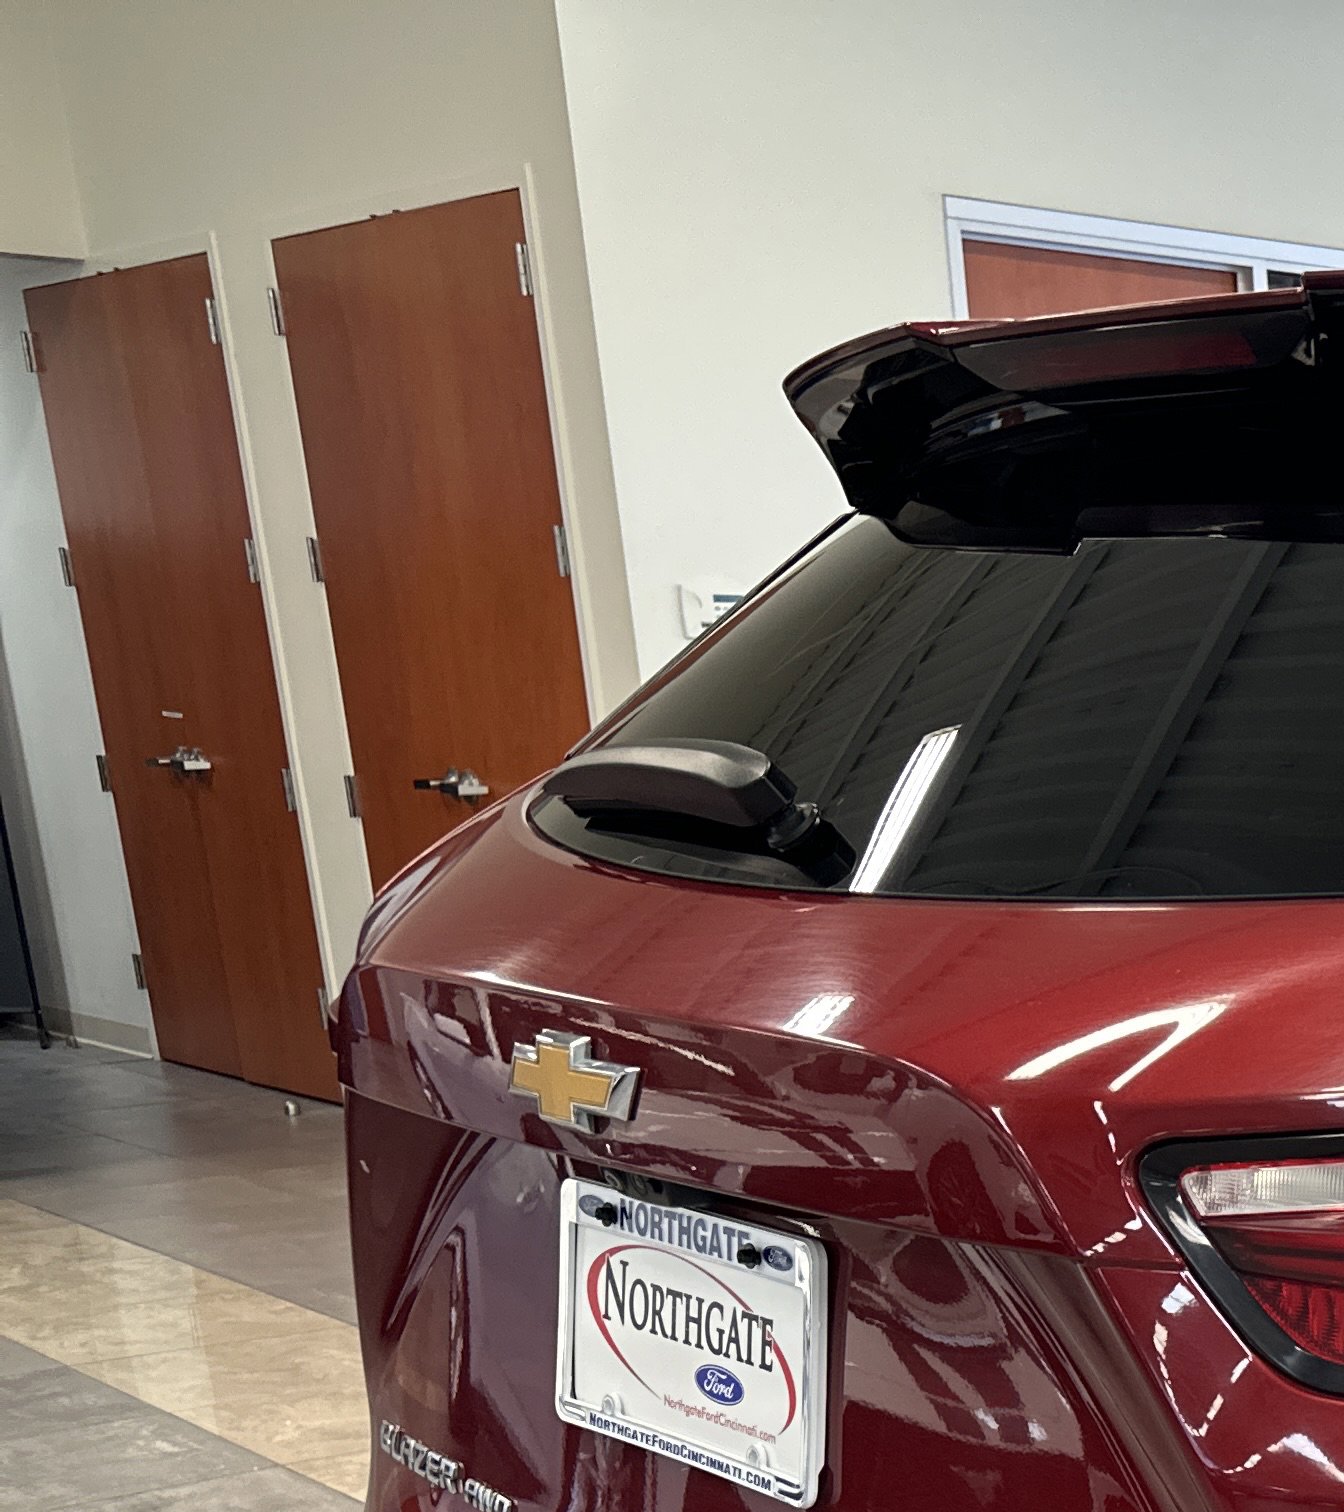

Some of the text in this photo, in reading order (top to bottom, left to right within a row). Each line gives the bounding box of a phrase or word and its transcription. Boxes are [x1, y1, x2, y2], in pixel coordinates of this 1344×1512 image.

[603, 1256, 774, 1373] NORTHGATE
[703, 1369, 734, 1399] Ford
[664, 1394, 776, 1445] NorthgateFordCincinnati.com
[381, 1420, 459, 1494] BLAZER
